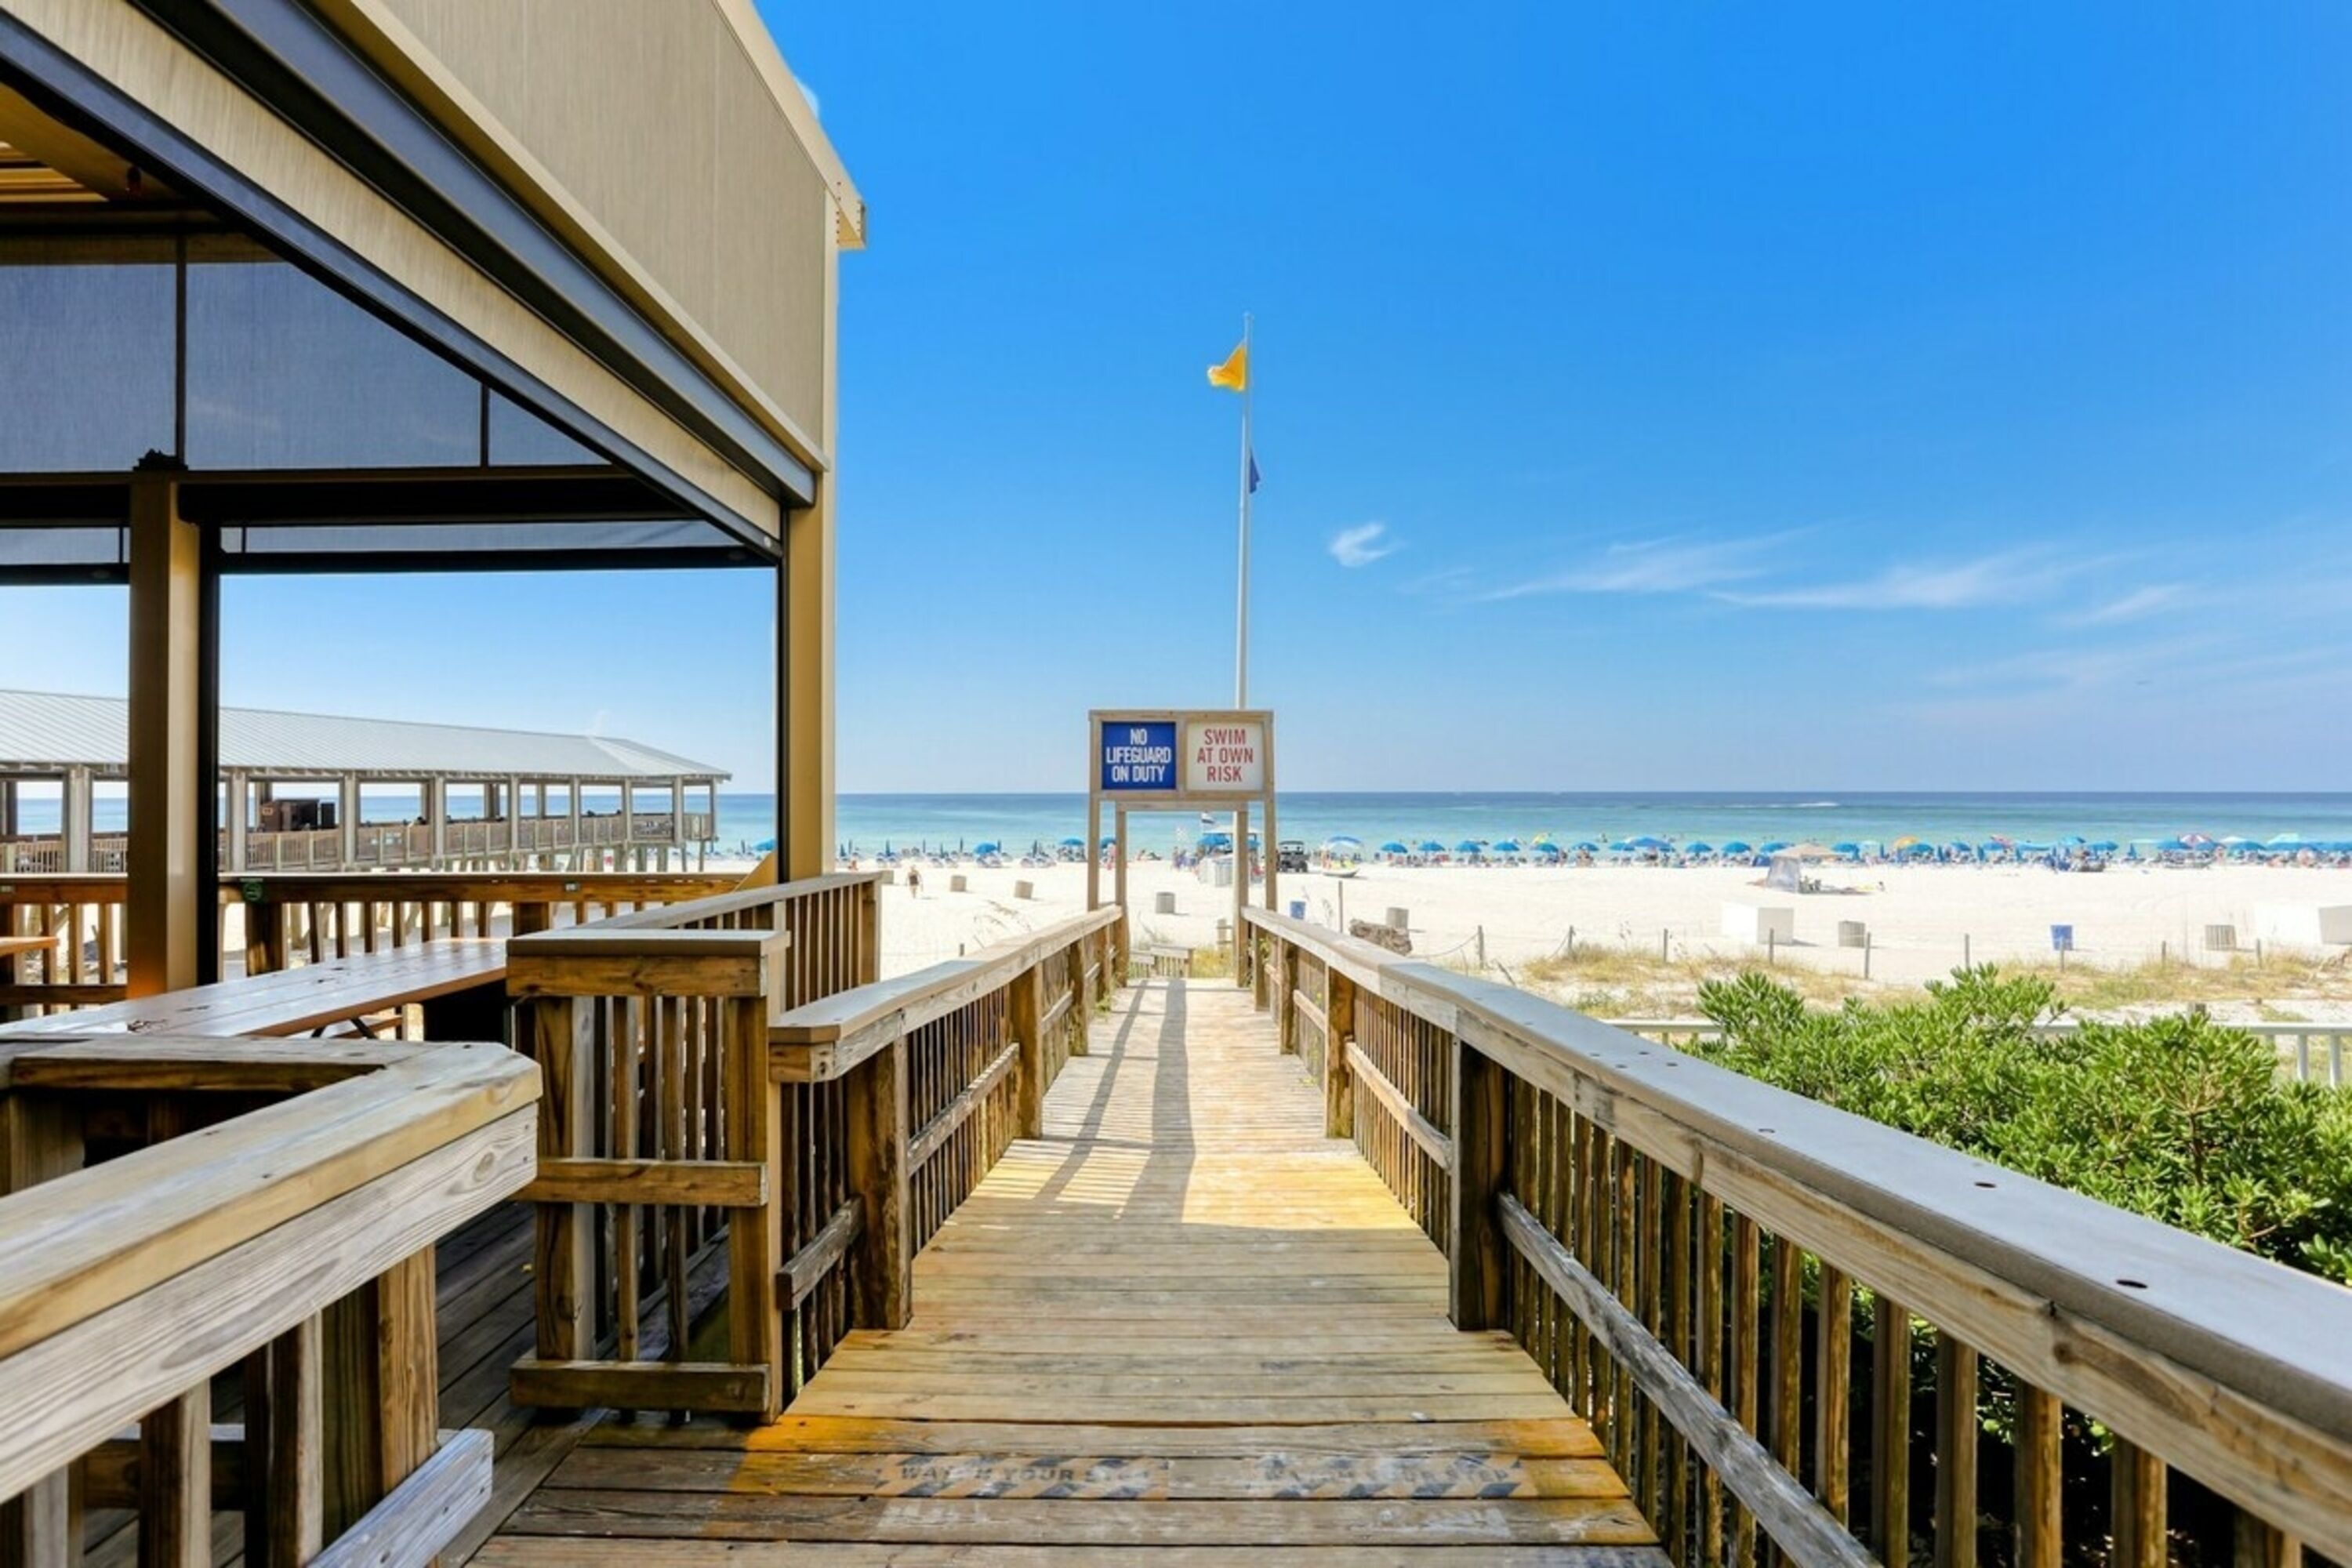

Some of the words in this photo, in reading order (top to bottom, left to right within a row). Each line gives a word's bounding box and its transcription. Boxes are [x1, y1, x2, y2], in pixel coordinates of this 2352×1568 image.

[1130, 728, 1148, 745] NO
[1204, 729, 1247, 746] SWIM
[1106, 747, 1171, 764] LIFEGUARD
[1197, 748, 1214, 764] AT
[1219, 748, 1254, 764] OWN
[1112, 765, 1129, 782] ON
[1133, 765, 1165, 782] DUTY
[1207, 766, 1242, 782] RISK
[901, 1466, 993, 1481] WAH
[1002, 1468, 1075, 1481] YOUR
